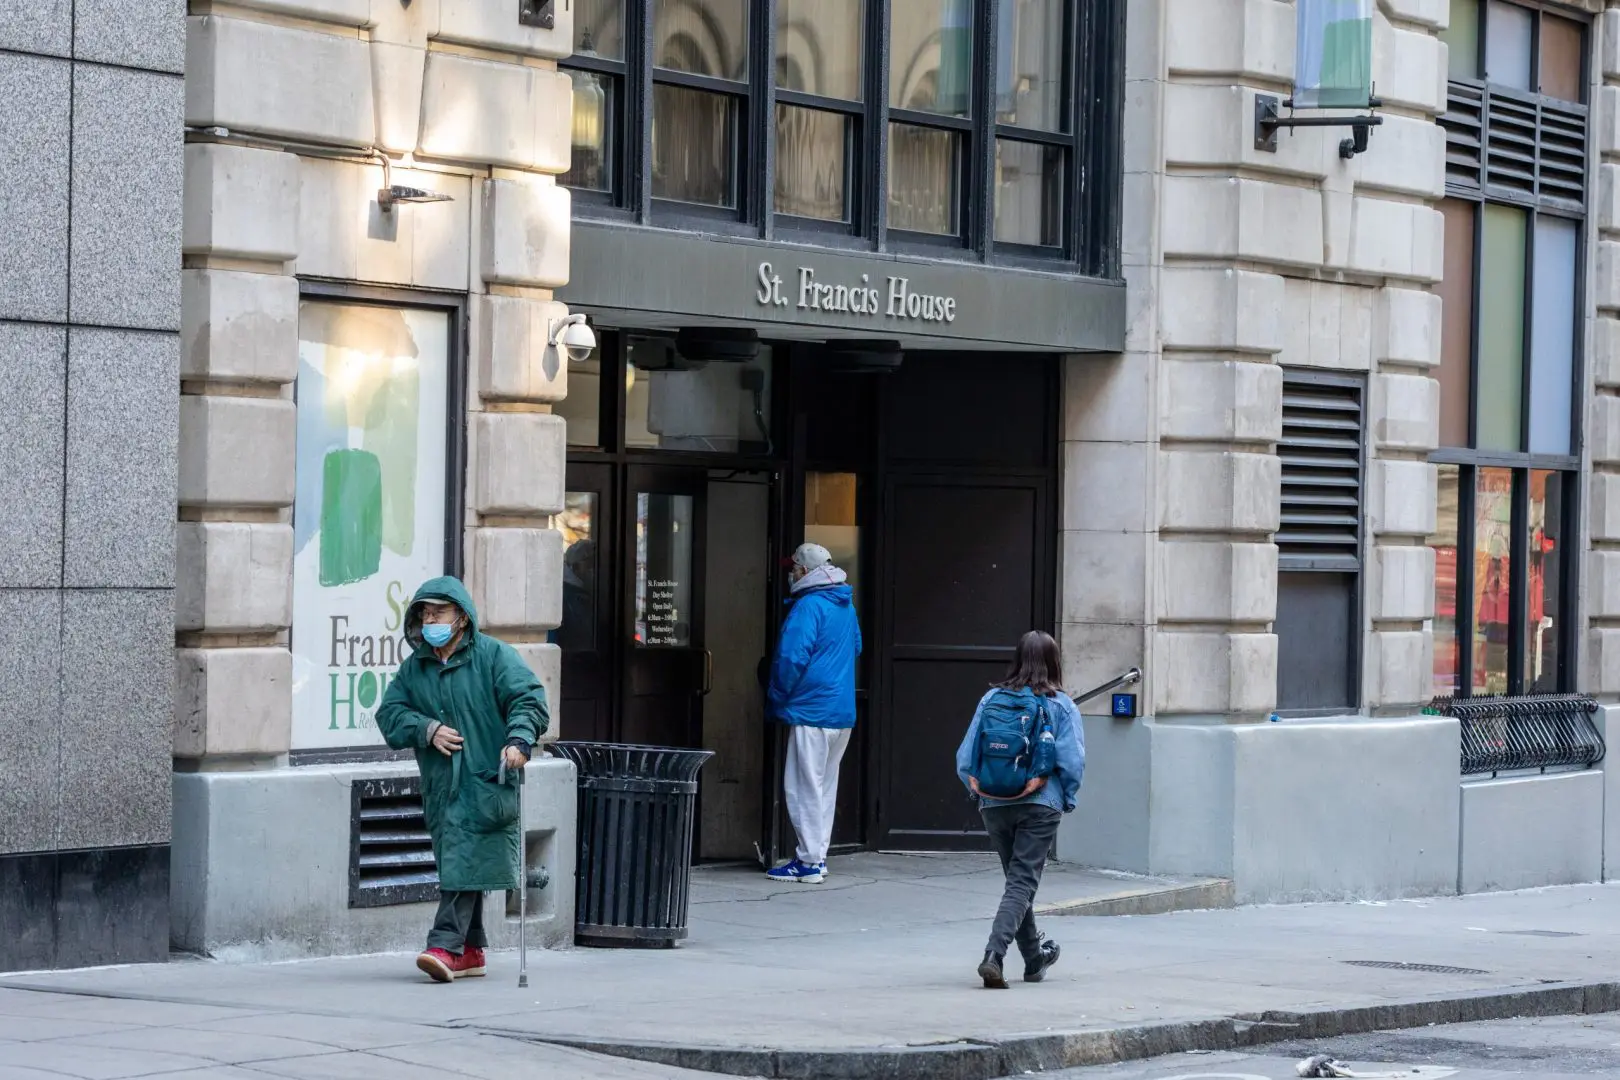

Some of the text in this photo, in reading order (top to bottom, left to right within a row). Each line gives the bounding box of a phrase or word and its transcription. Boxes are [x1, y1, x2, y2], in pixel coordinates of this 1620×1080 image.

[756, 262, 956, 322] St. Francis House
[652, 603, 663, 611] Open
[328, 615, 406, 667] Franc
